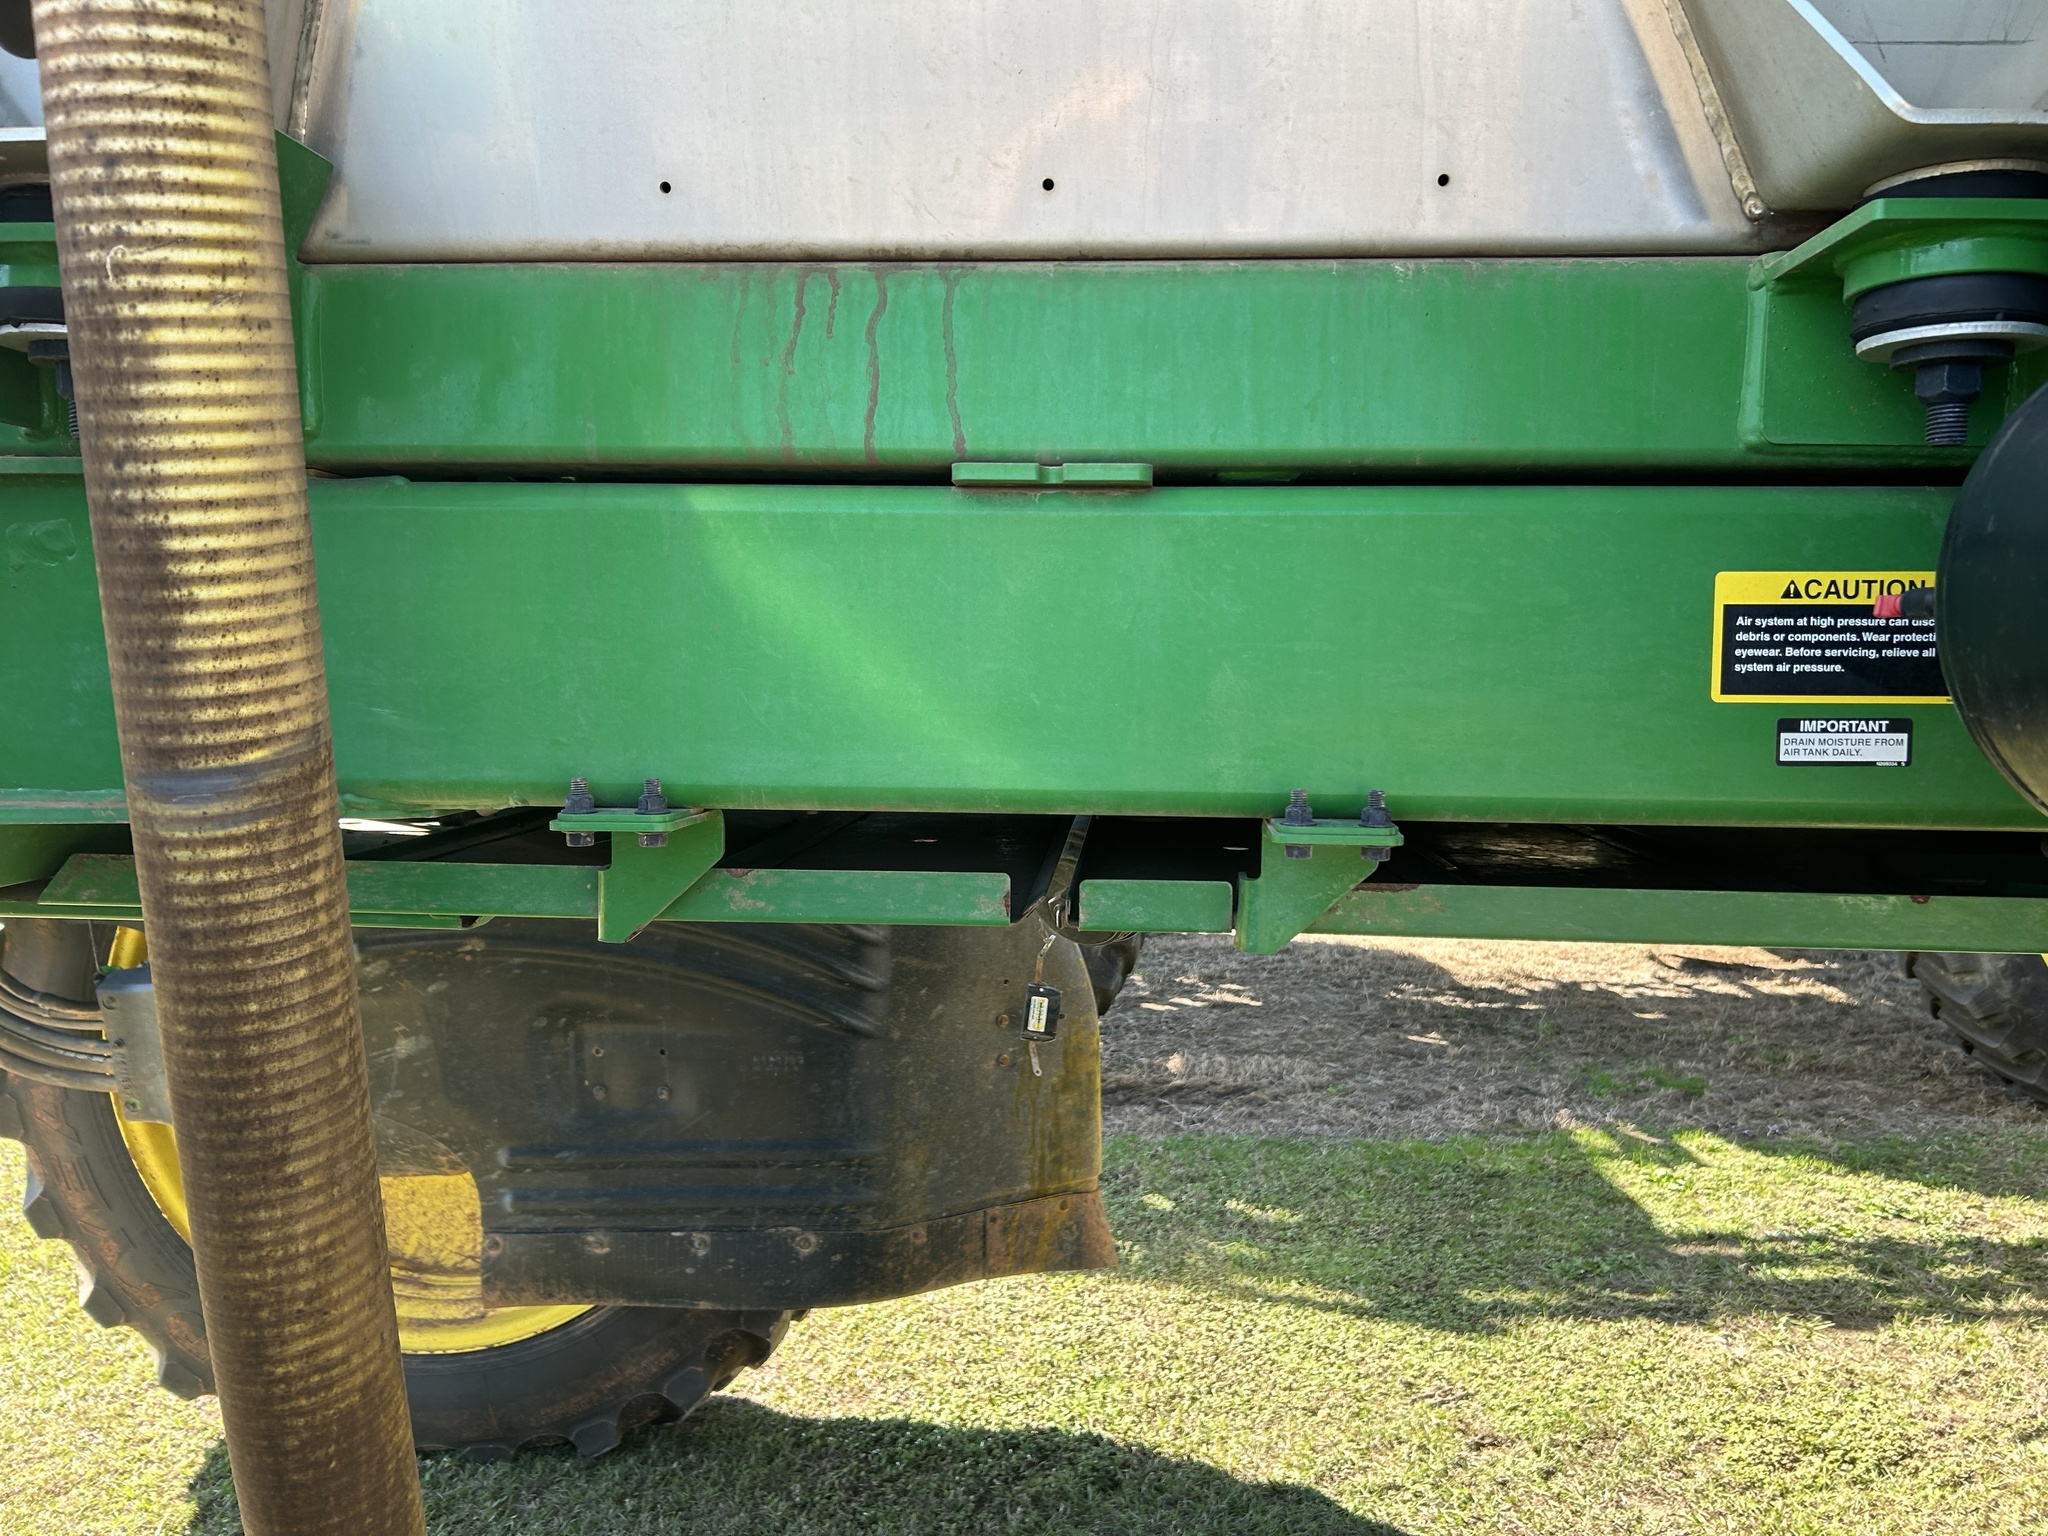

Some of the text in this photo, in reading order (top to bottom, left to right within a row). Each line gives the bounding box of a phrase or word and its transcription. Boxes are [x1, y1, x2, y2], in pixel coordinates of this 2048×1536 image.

[1736, 616, 1752, 626] Air
[1754, 616, 1794, 628] system
[1796, 616, 1808, 626] at
[1809, 616, 1834, 628] high
[1837, 618, 1886, 628] pressure
[1888, 618, 1909, 626] can
[1735, 631, 1936, 644] debris or components. Wear protecti
[1735, 647, 1936, 659] eyewear. Before servicing, relieve all
[1734, 662, 1845, 674] system air pressure.
[1800, 720, 1889, 732] IMPORTANT
[1783, 738, 1904, 746] DRAIN MOISTURE FROM
[1783, 748, 1863, 757] AIR TANK DAILY.
